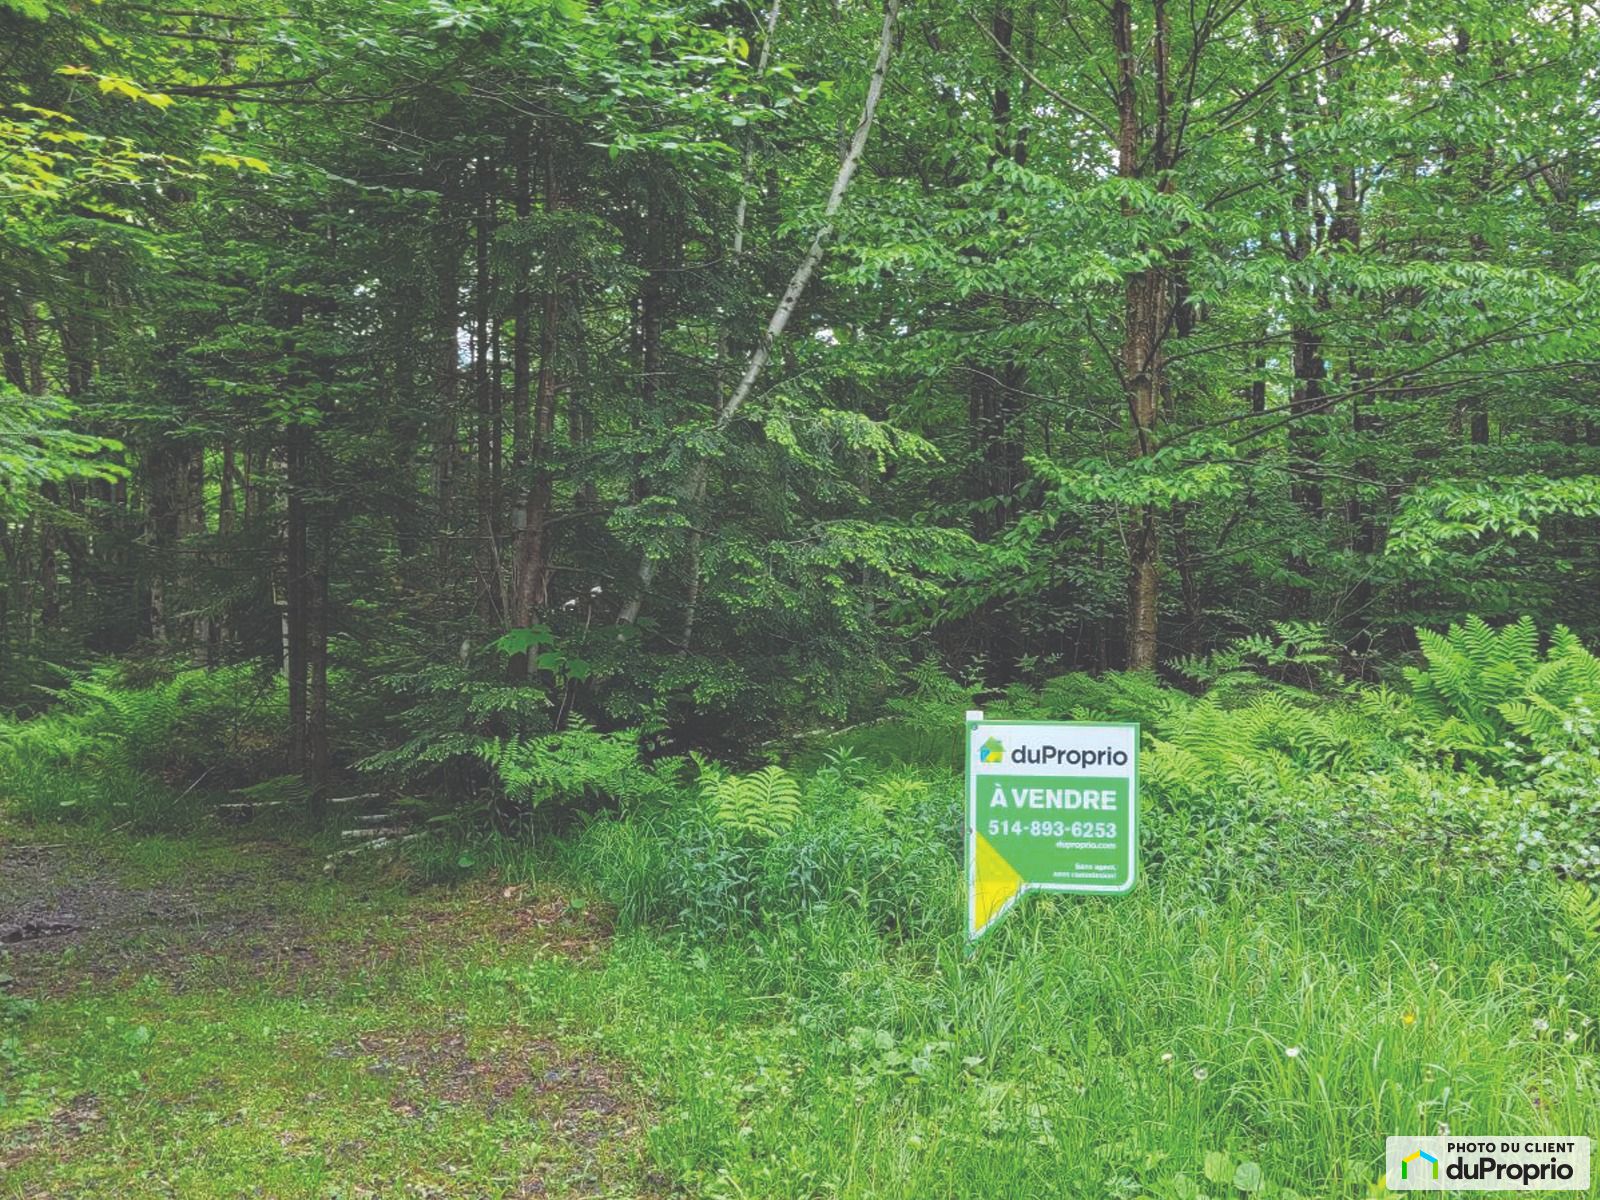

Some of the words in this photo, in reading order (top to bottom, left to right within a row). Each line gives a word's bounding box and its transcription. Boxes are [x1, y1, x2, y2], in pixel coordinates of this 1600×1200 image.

[1011, 745, 1128, 768] duProprio
[990, 783, 1008, 808] À
[1011, 788, 1117, 810] VENDRE
[988, 820, 1117, 838] 514-893-6253
